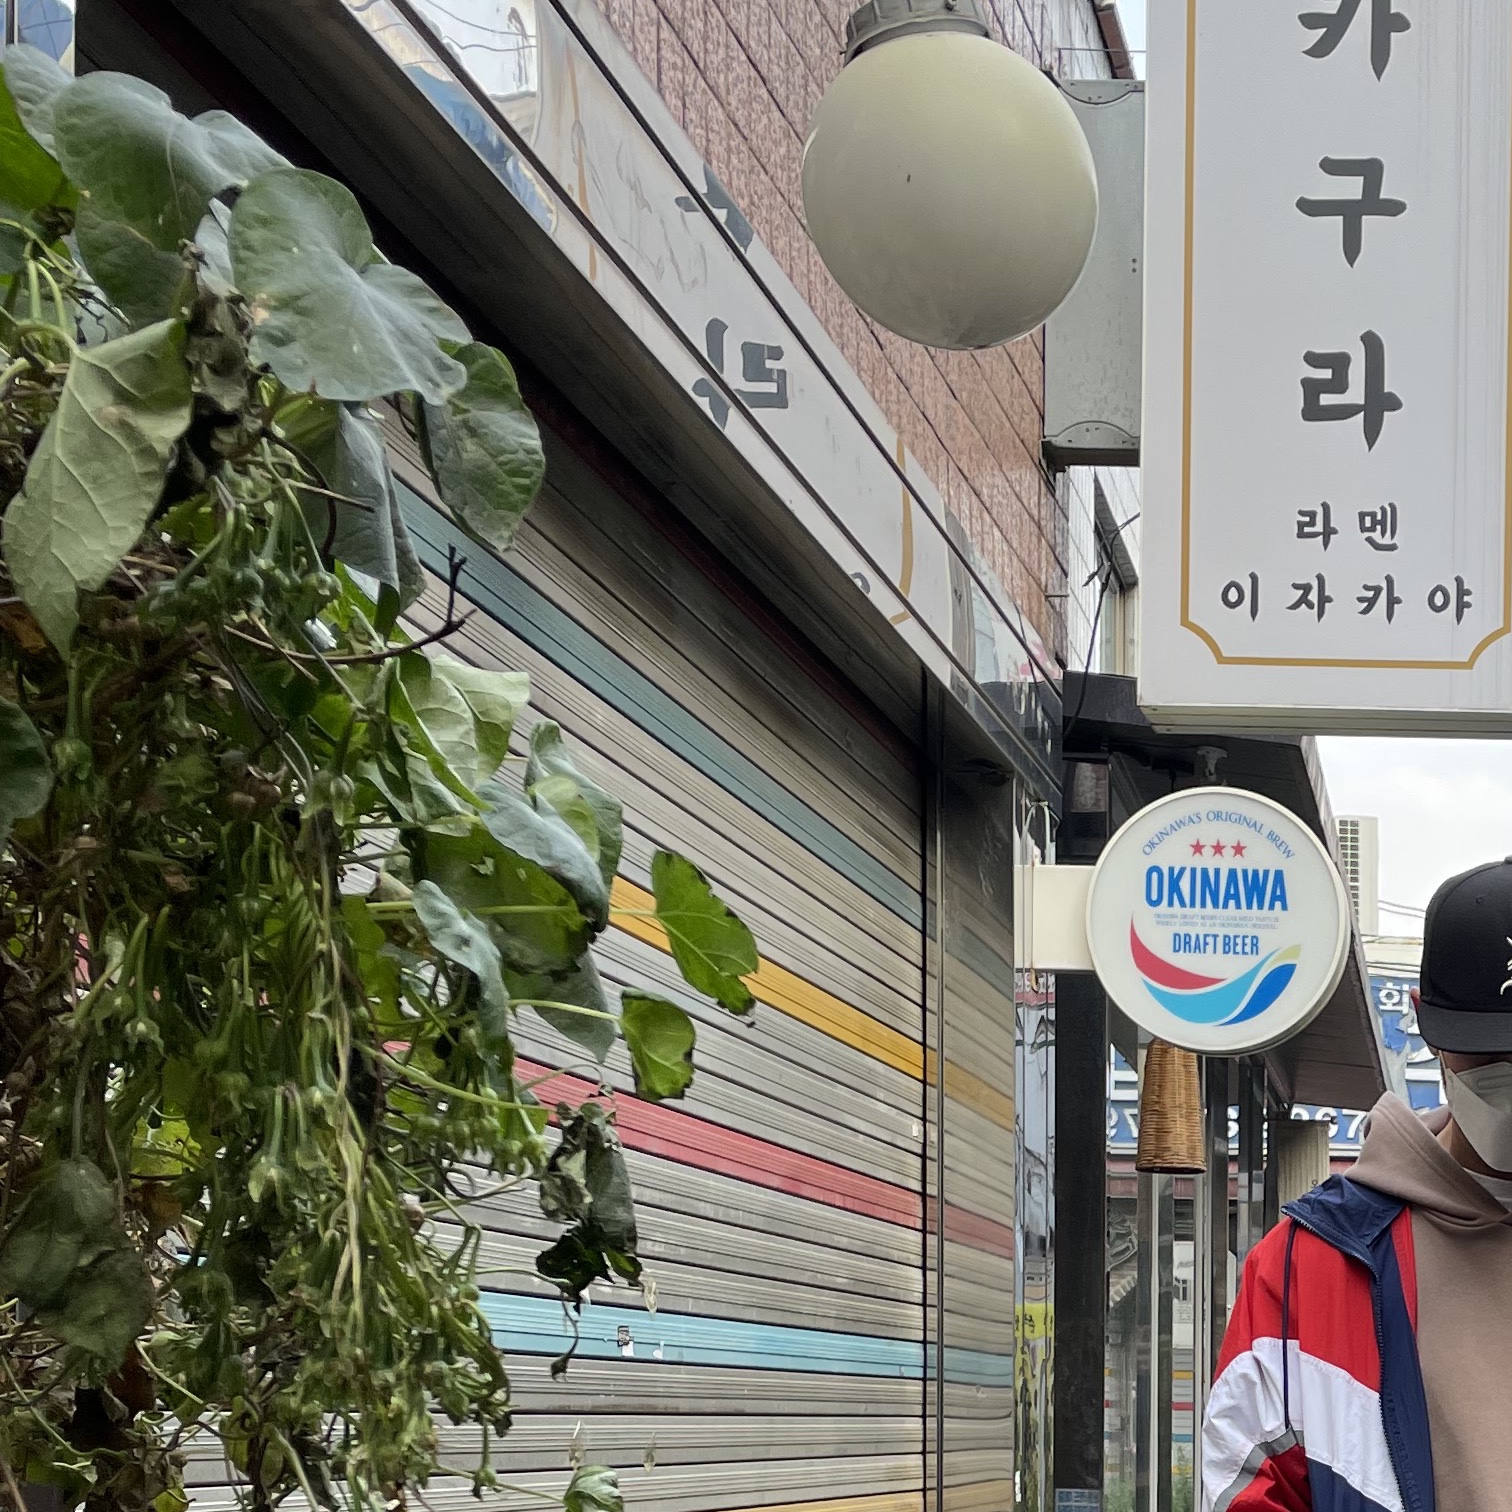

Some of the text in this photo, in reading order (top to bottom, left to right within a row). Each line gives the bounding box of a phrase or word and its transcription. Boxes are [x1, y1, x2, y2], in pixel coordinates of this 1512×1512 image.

[1296, 501, 1399, 552] 라멘
[1221, 571, 1473, 626] 이자카야
[1143, 810, 1296, 860] OKINAWA'S ORIGINAL BREW
[1145, 865, 1288, 912] OKINAWA
[1172, 932, 1260, 956] DRAFT BEER
